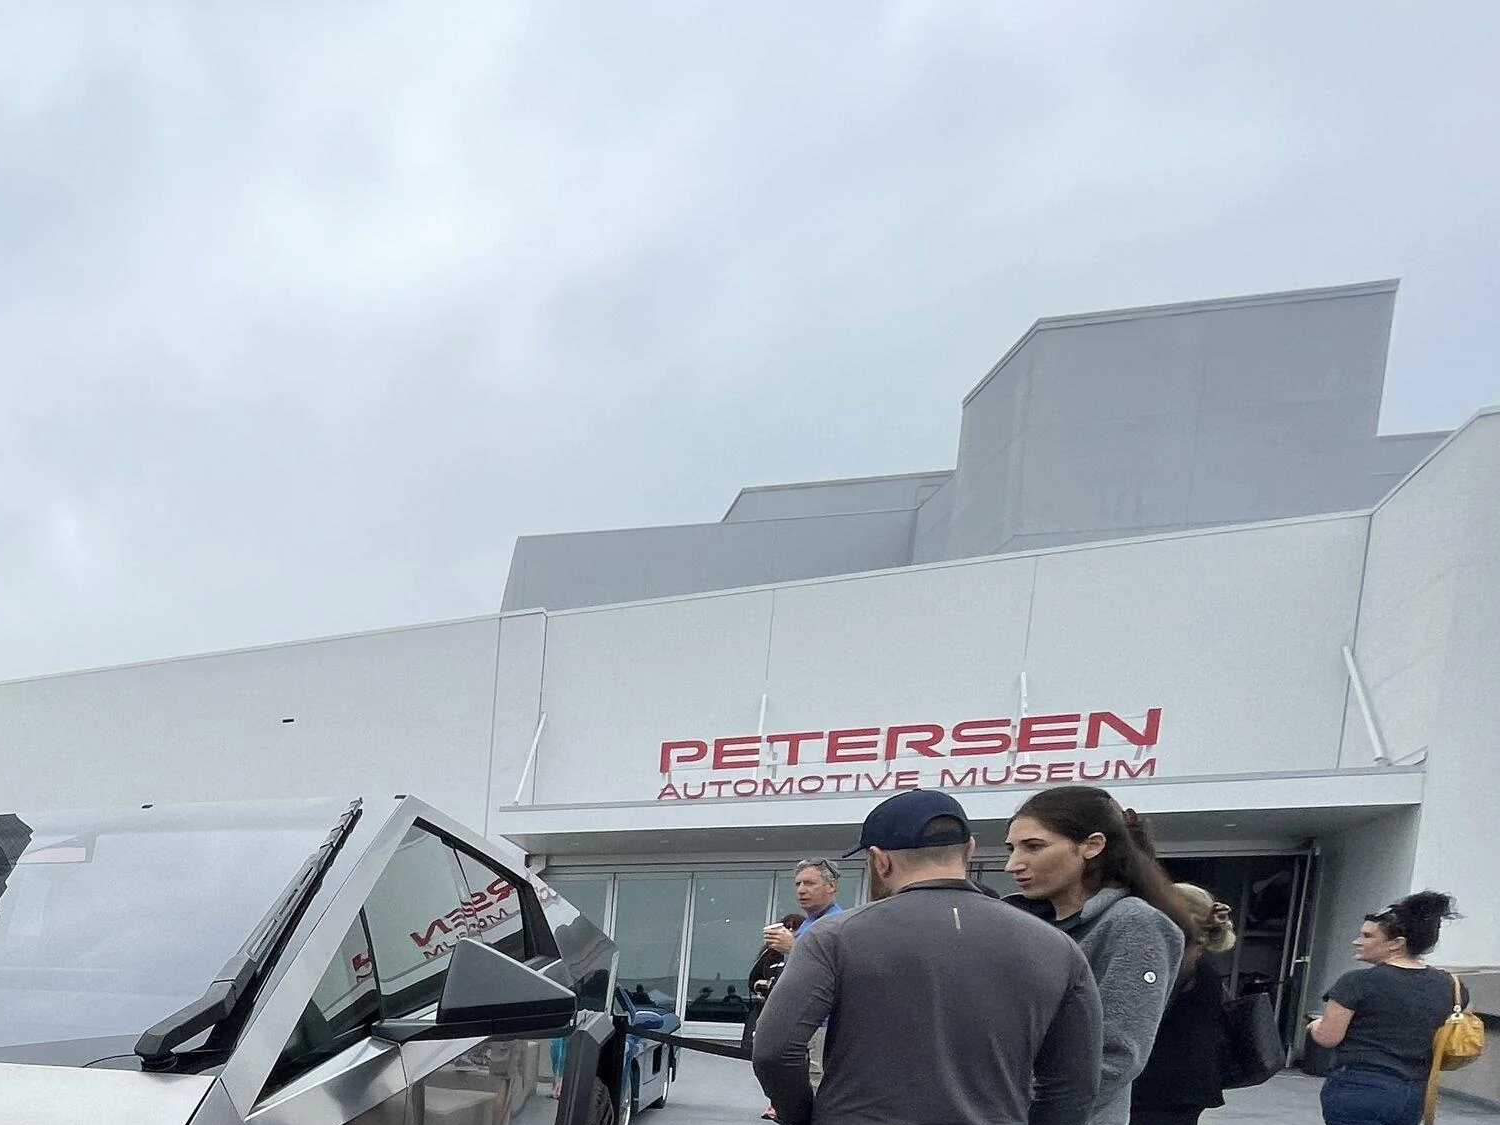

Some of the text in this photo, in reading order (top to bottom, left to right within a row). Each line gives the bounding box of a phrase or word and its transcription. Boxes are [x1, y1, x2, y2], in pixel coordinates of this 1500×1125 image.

[659, 708, 1162, 773] PETERSEN
[657, 758, 1156, 800] AUTOMOTIVE MUSEUM
